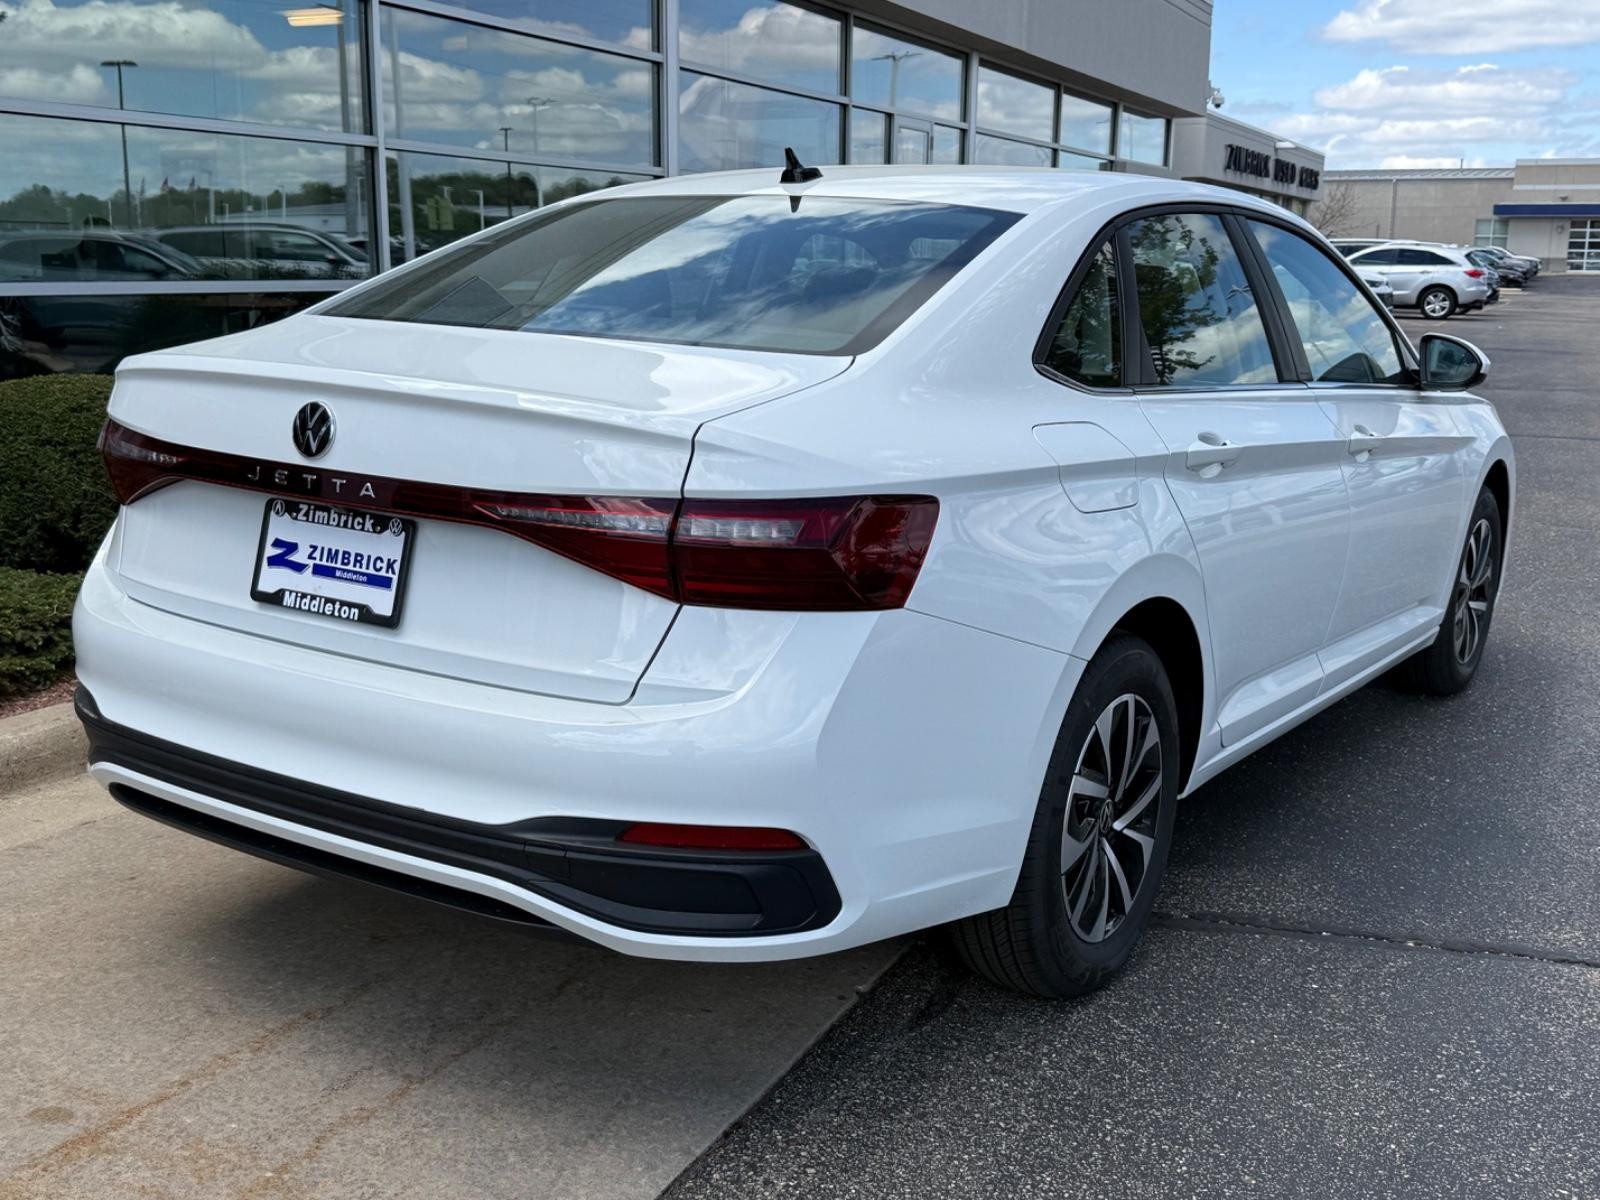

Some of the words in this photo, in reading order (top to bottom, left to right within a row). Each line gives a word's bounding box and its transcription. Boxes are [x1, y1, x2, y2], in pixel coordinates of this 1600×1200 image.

[247, 465, 376, 499] JETTA
[296, 504, 375, 533] Zimbrick
[307, 544, 399, 576] ZIMBRICK
[335, 569, 368, 583] Middleton
[282, 590, 360, 621] Middleton
